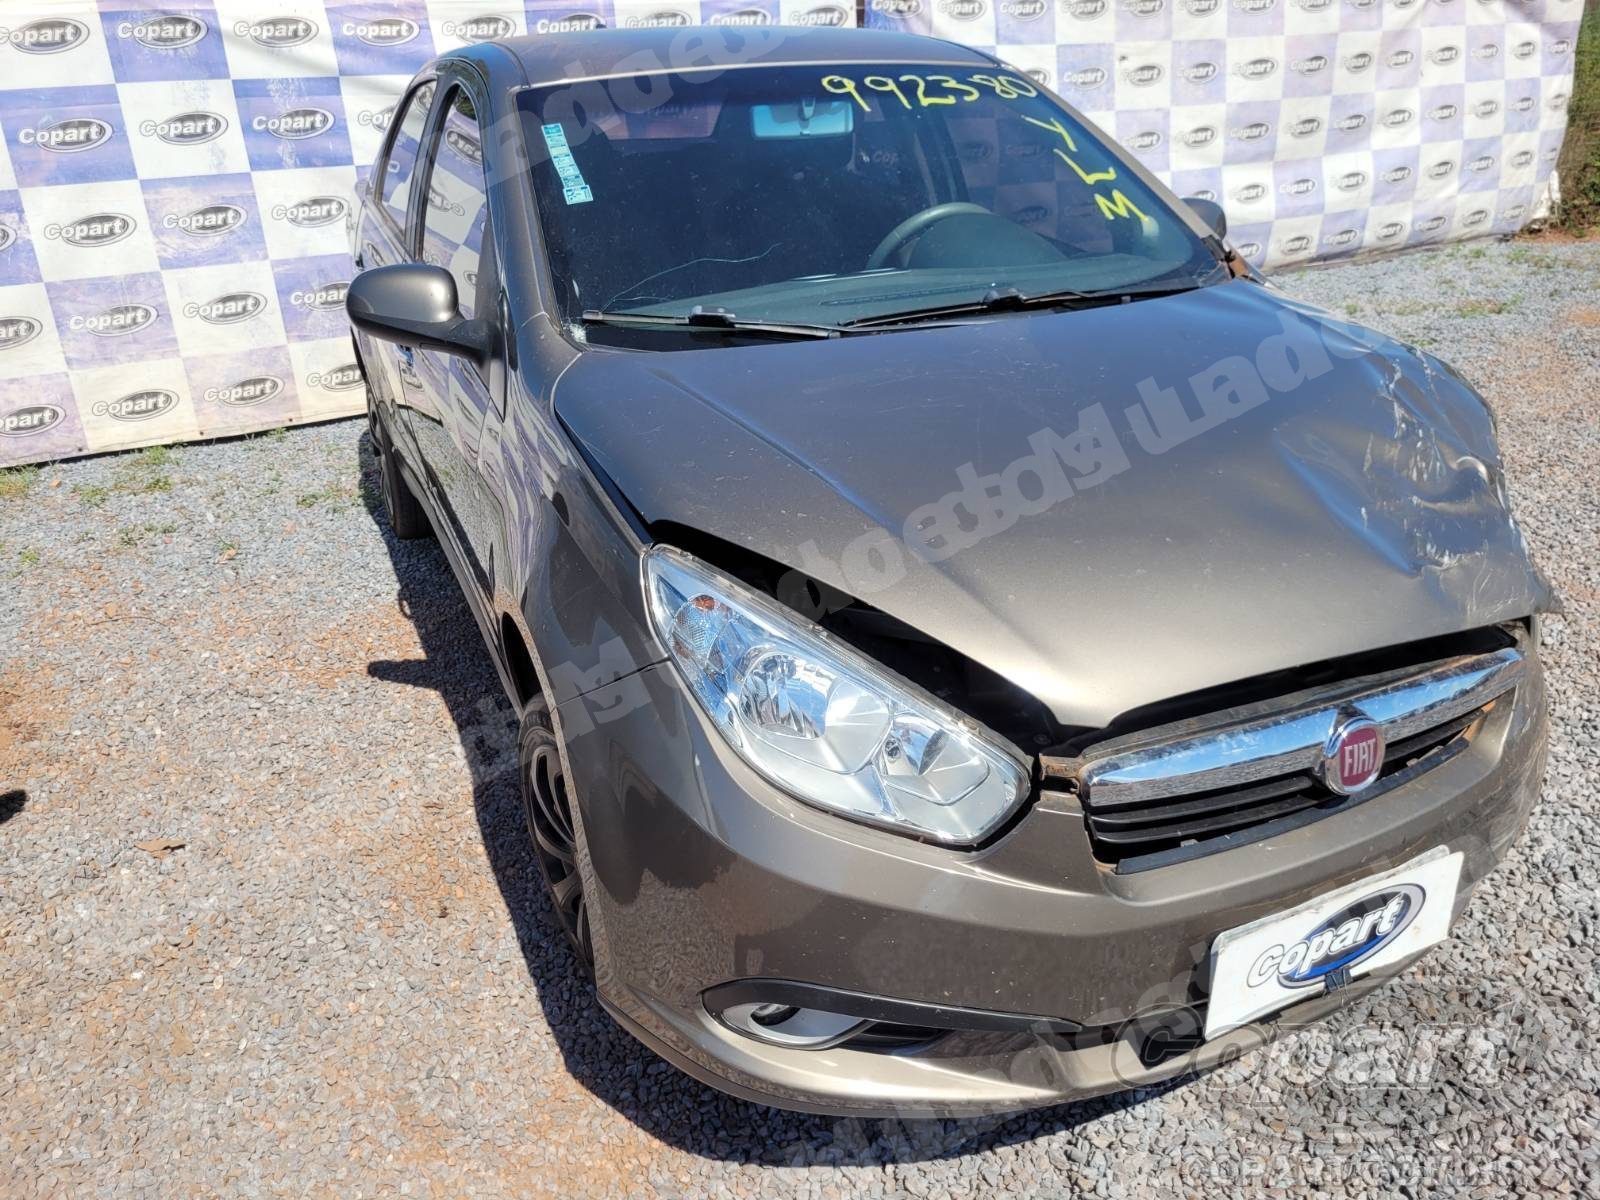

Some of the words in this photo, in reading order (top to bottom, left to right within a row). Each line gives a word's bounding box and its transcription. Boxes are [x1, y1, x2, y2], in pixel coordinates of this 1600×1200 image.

[442, 20, 505, 38] Copart
[537, 18, 596, 34] Copart
[789, 11, 841, 26] Copart
[117, 21, 195, 42] Copart
[233, 20, 306, 40] Copart
[342, 21, 410, 39] Copart
[822, 74, 1039, 112] 992380
[140, 117, 214, 137] Copart
[252, 113, 324, 135] Copart
[357, 110, 392, 129] Cop
[18, 126, 100, 146] Copart
[162, 209, 236, 231] Copart
[272, 201, 341, 222] Copart
[44, 219, 123, 241] Copart
[290, 287, 349, 308] Copar
[69, 308, 146, 331] Copart
[183, 297, 256, 321] Copart
[306, 369, 361, 388] Copa
[203, 380, 275, 403] Copart
[92, 394, 168, 417] Copart
[0, 409, 54, 433] part
[1343, 737, 1378, 778] FIAT
[1246, 892, 1406, 989] Copart
